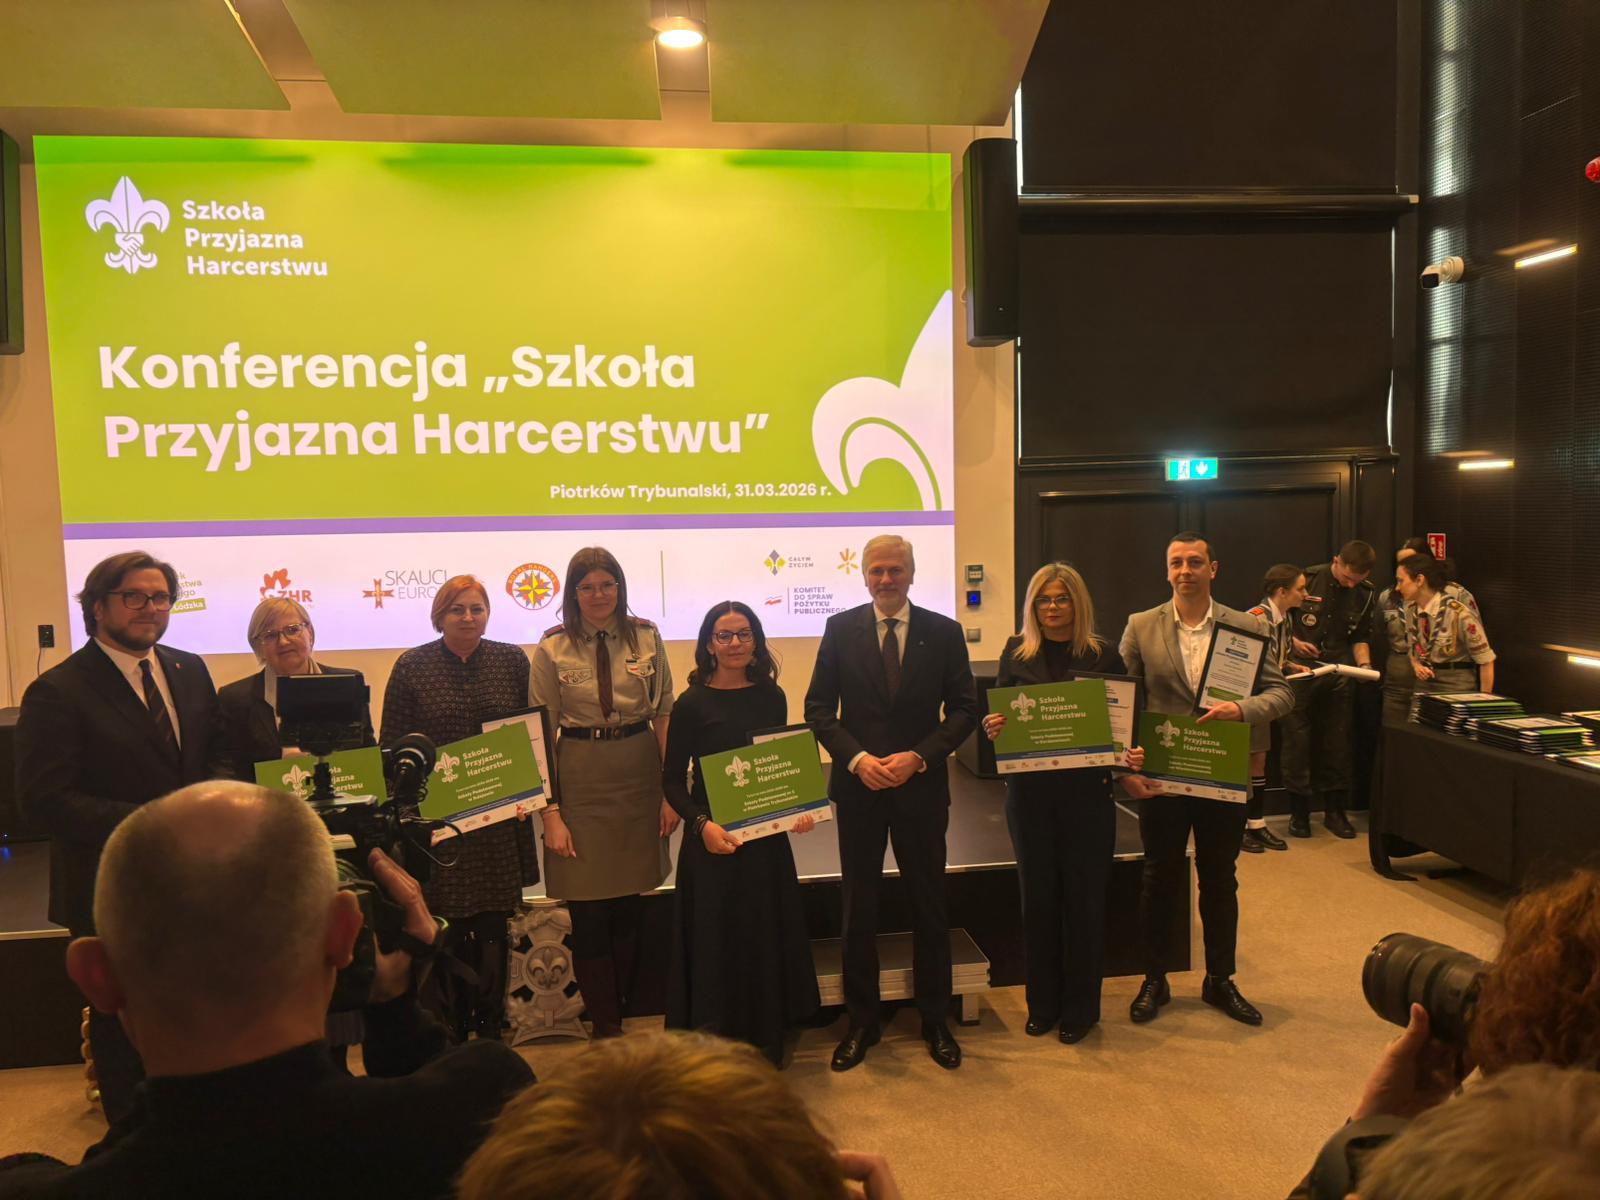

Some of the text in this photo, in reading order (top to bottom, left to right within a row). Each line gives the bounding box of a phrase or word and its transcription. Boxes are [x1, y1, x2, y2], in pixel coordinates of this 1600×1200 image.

[182, 200, 265, 221] Szkoła
[185, 228, 304, 253] Przyjazna
[187, 256, 328, 276] Harcerstwu
[100, 341, 694, 402] Konferencja „Szkoła
[105, 410, 397, 471] Przyjazna
[550, 483, 832, 502] Piotrków Trybunalski, 31.03.2026 r.
[398, 586, 438, 599] EURO
[1040, 703, 1078, 713] Przyjazna
[1041, 711, 1087, 721] Harcerstwu
[463, 747, 489, 760] Szkoła
[465, 752, 503, 768] Przyjazna
[753, 753, 779, 765] Szkoła
[467, 758, 513, 777] Harcerstwu
[755, 760, 792, 774] Przyjazna
[757, 768, 801, 783] Harcerstwu
